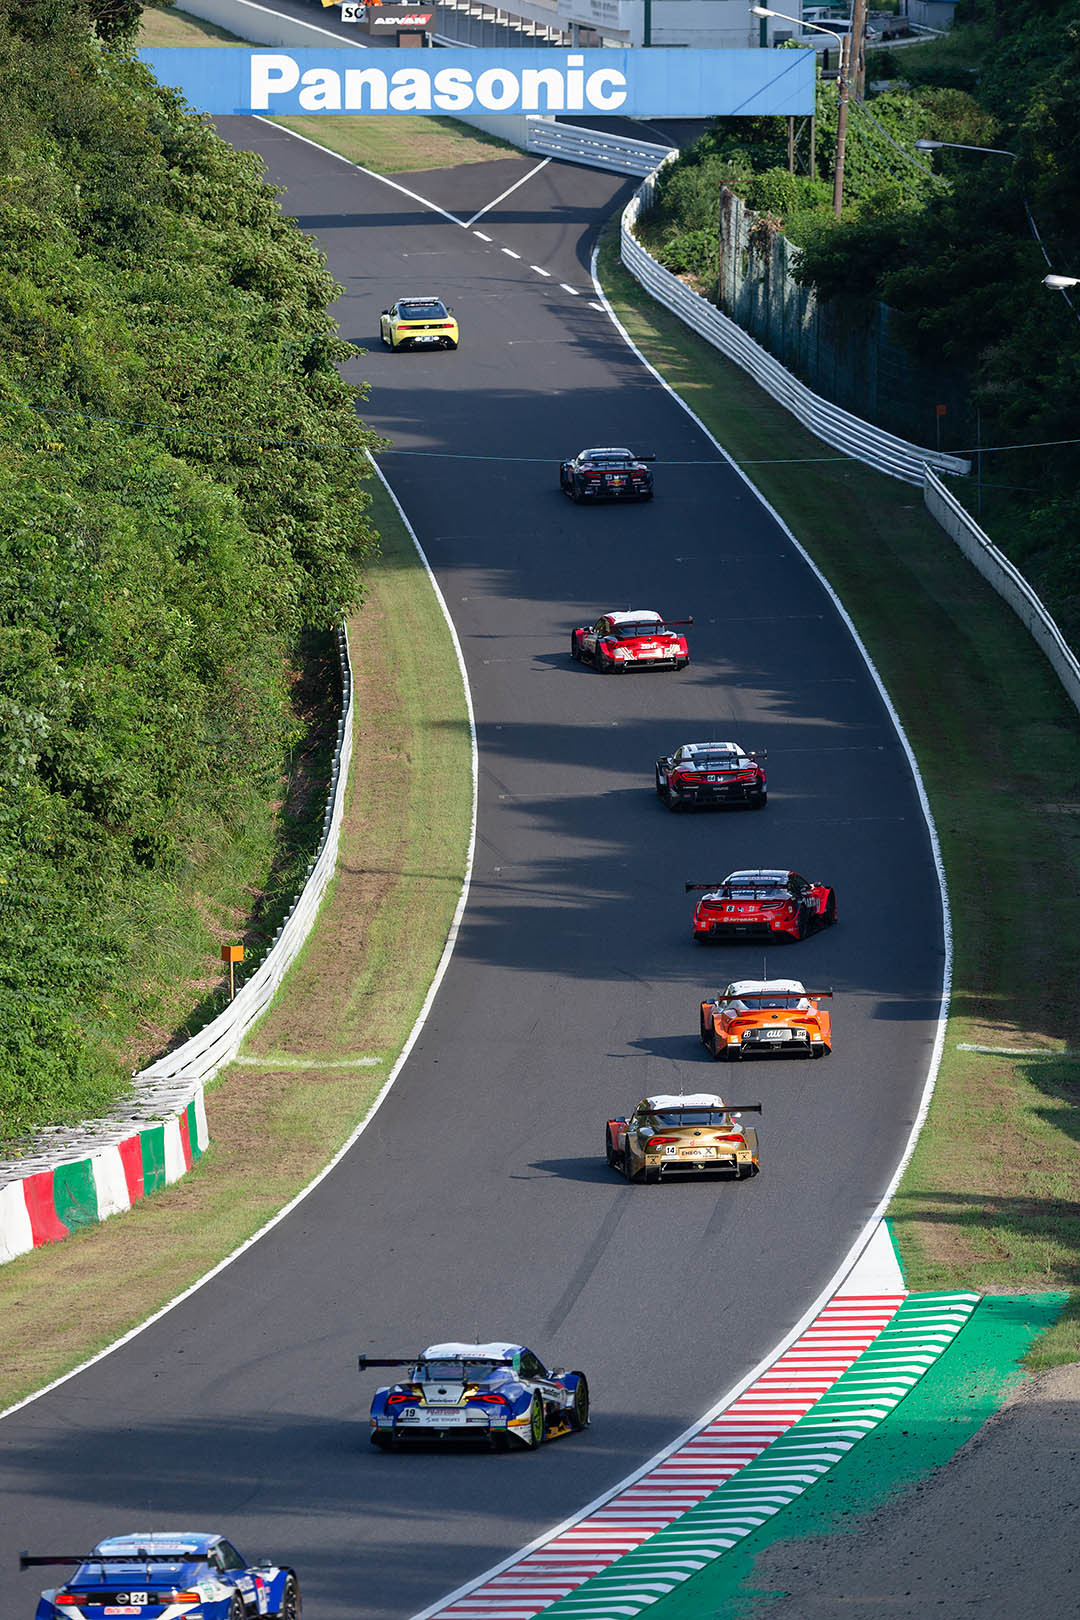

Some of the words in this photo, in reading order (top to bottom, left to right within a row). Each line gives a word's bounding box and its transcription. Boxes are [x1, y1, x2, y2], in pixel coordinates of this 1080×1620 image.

[344, 7, 364, 19] SC
[374, 16, 429, 25] ADVAN
[250, 54, 627, 111] Panasonic
[766, 1030, 783, 1038] au
[405, 1408, 416, 1417] 19
[132, 1594, 145, 1603] 24
